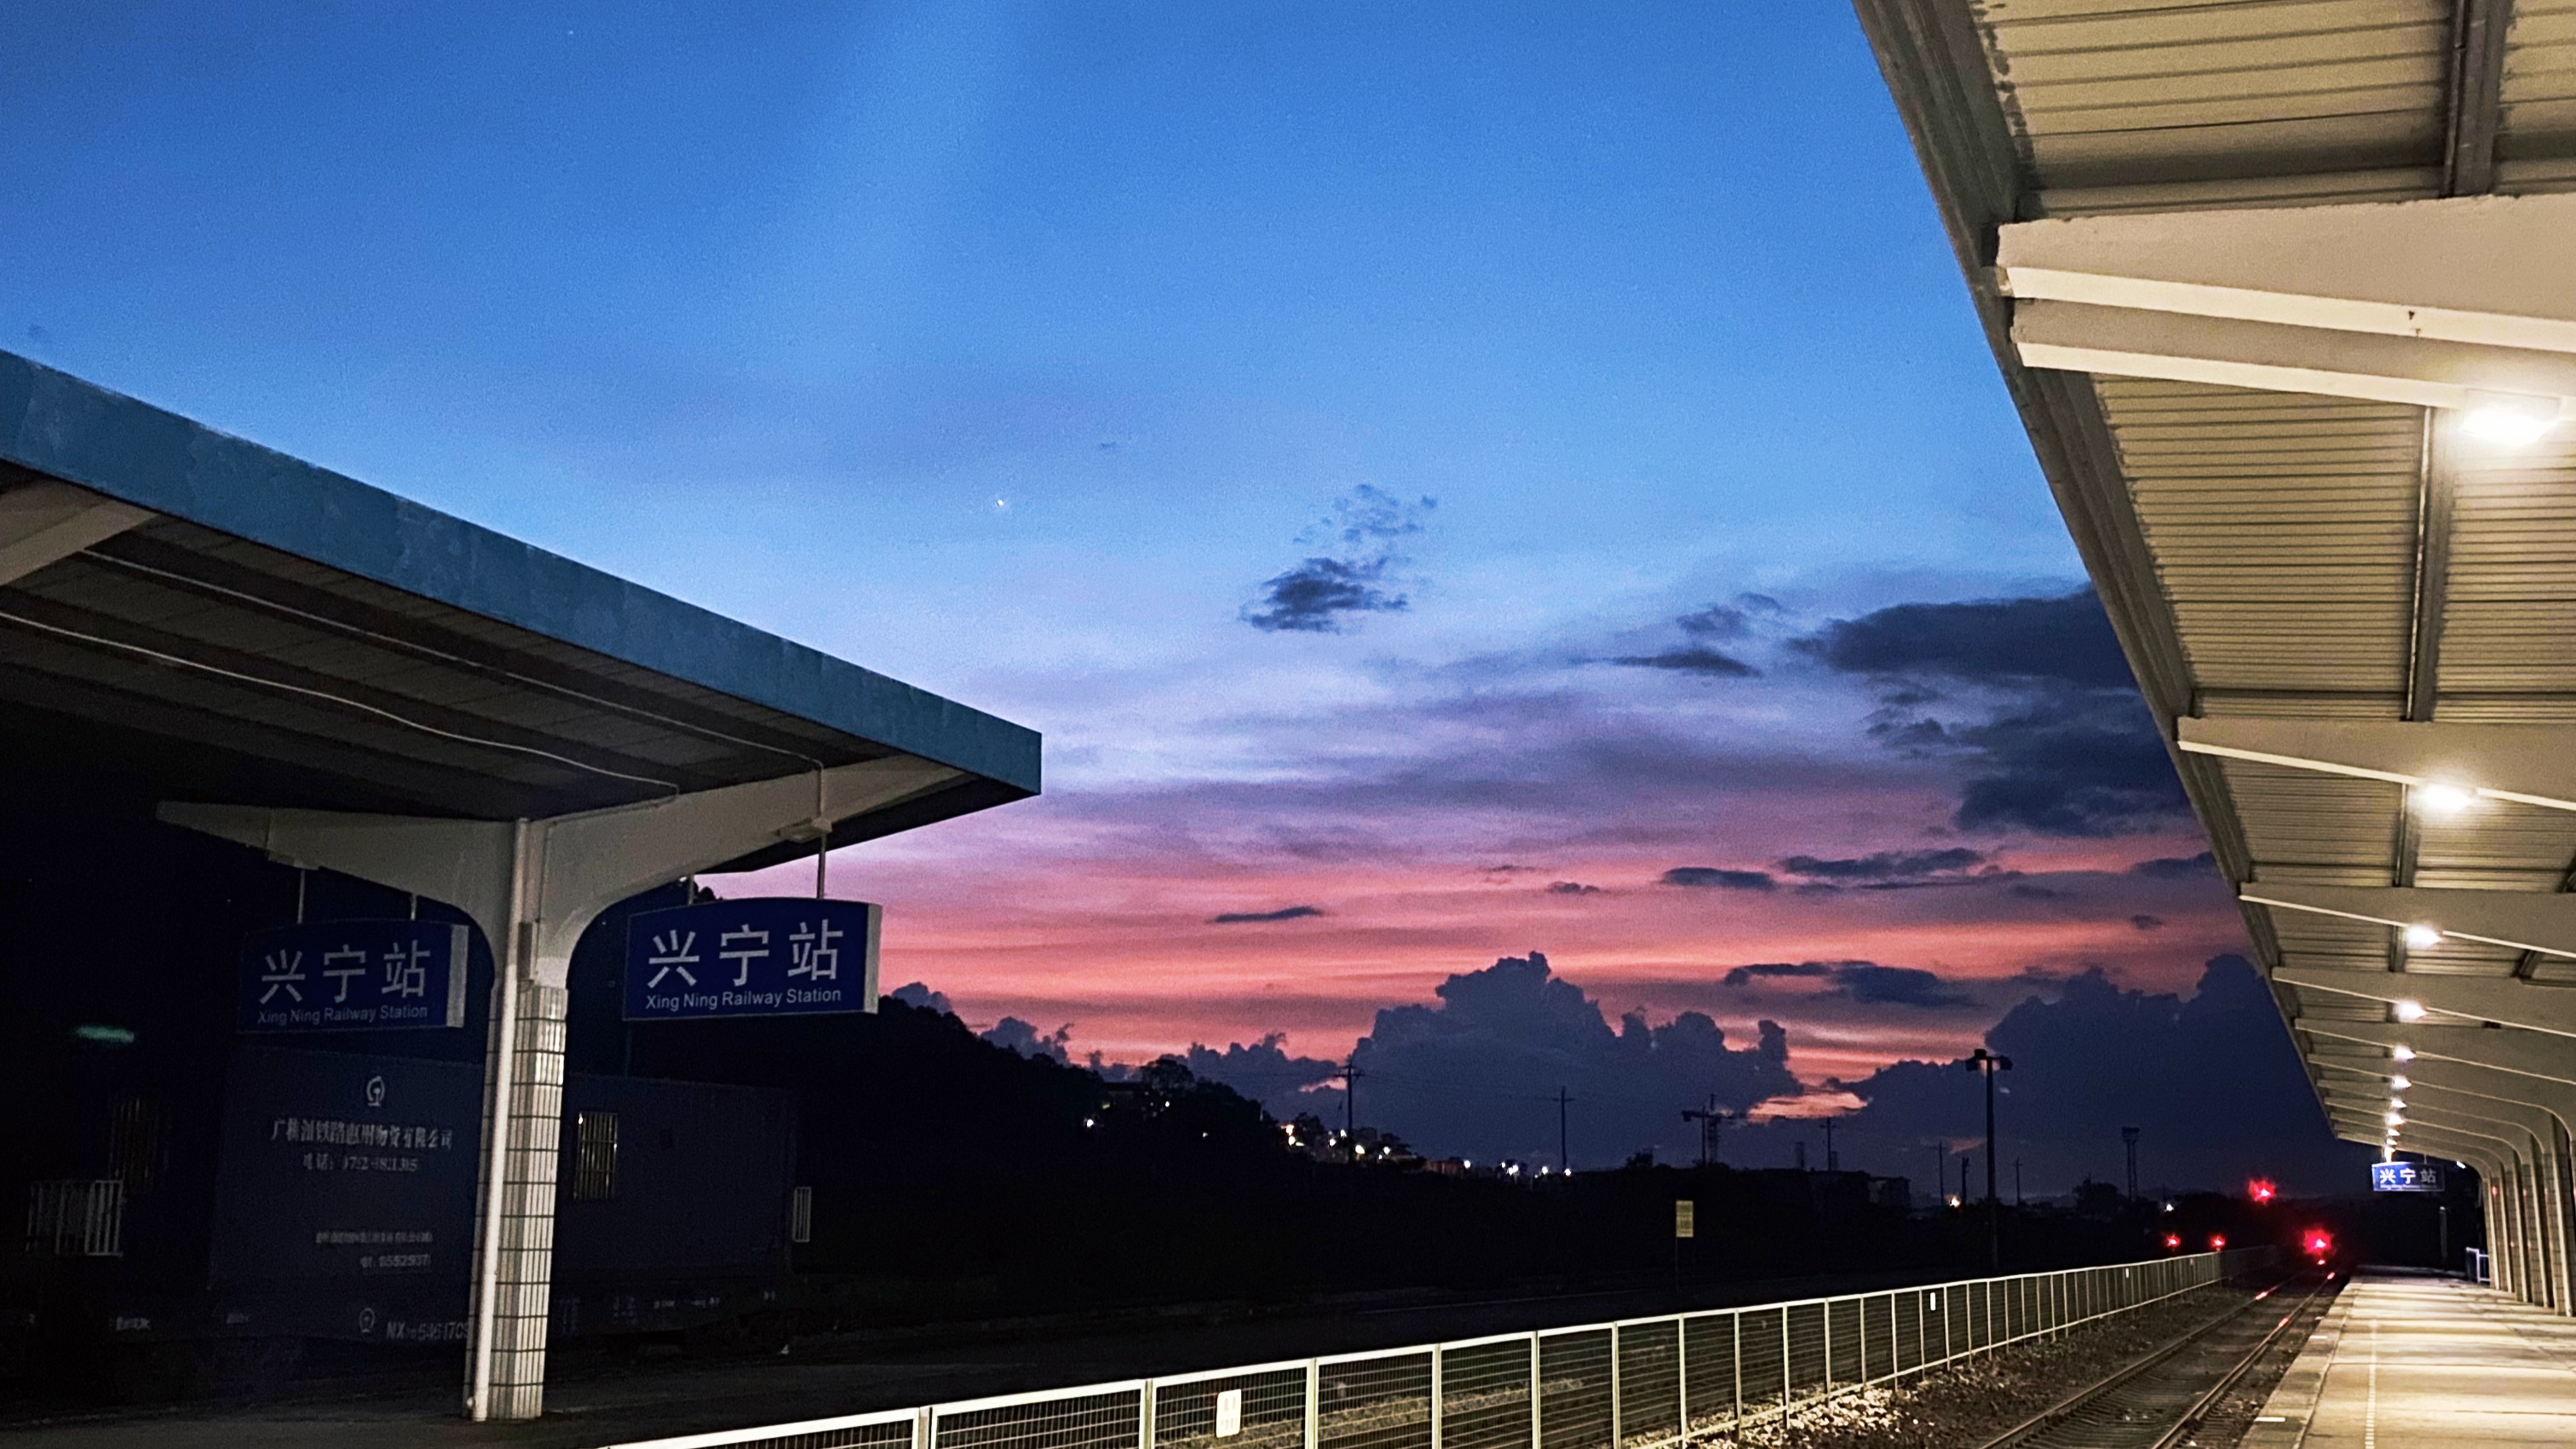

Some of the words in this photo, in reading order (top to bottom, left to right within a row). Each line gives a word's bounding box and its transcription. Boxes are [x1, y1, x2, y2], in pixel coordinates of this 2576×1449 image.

[647, 918, 843, 989] 兴宁站
[259, 939, 431, 1005] 兴宁站
[645, 995, 679, 1012] Xing
[682, 992, 718, 1010] Ning
[722, 989, 783, 1008] Railway
[785, 986, 842, 1003] Station
[257, 1010, 287, 1026] Xing
[290, 1009, 320, 1025] Ning
[324, 1006, 377, 1023] Railway
[379, 1004, 428, 1019] Station
[2379, 1167, 2437, 1184] 兴宁站
